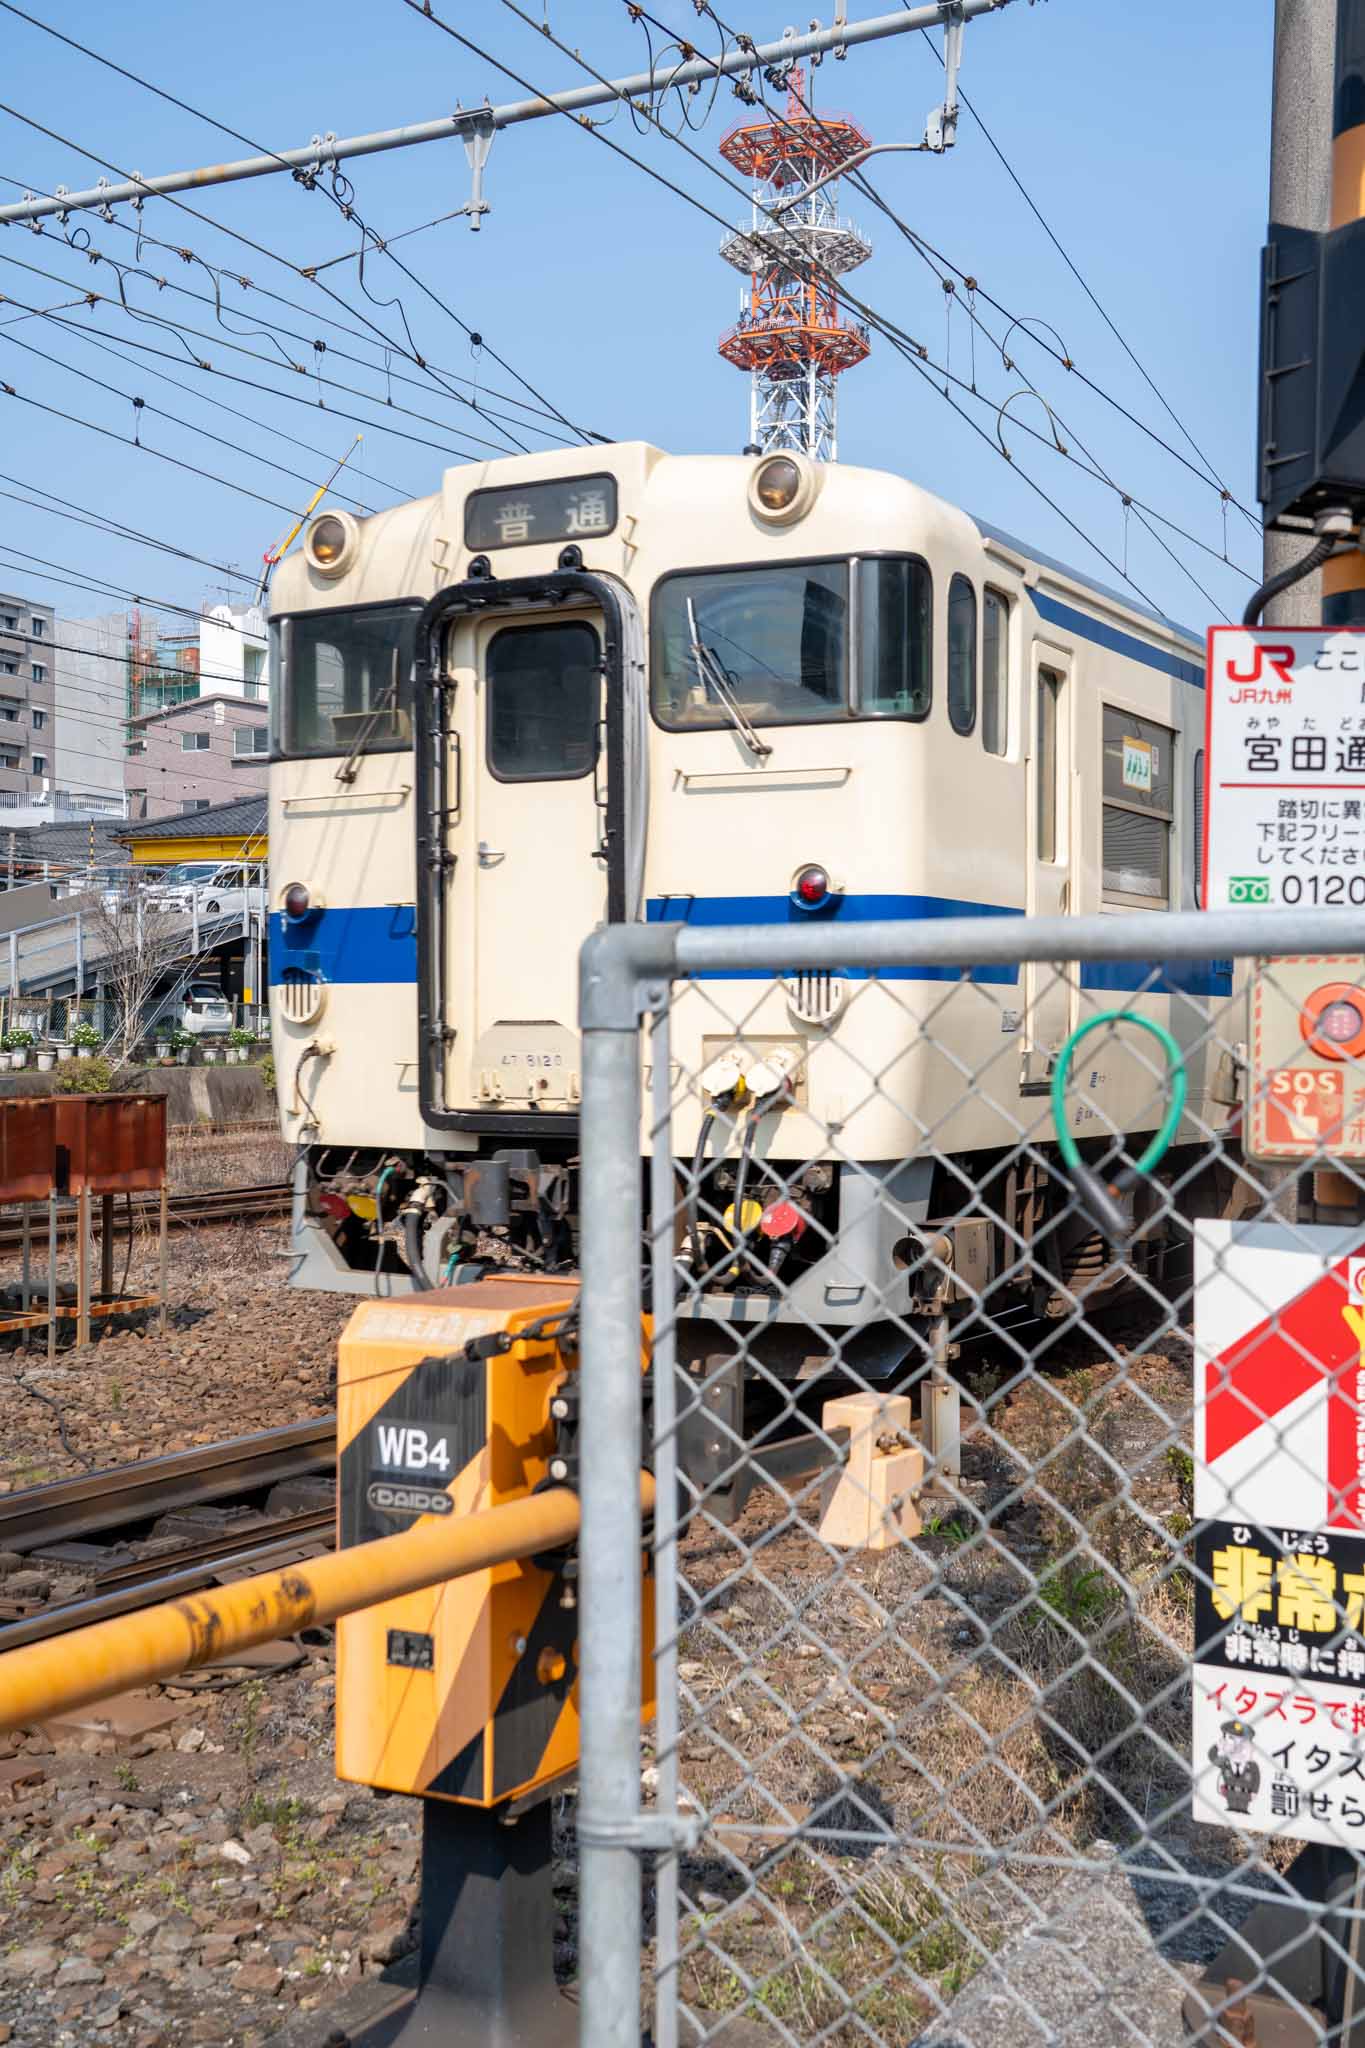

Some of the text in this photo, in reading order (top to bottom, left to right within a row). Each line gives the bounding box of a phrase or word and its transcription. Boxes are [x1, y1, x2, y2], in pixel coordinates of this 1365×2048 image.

[494, 491, 610, 543] 普通
[1226, 645, 1296, 682] JR
[1229, 688, 1292, 704] JR九州
[1278, 799, 1365, 819] 踏切に異
[1256, 822, 1365, 842] 下記フリー
[1257, 846, 1365, 865] してくださ
[1282, 875, 1365, 905] 0120
[1273, 1071, 1336, 1094] SOS
[378, 1425, 450, 1471] WB4
[377, 1489, 448, 1512] DAIDO
